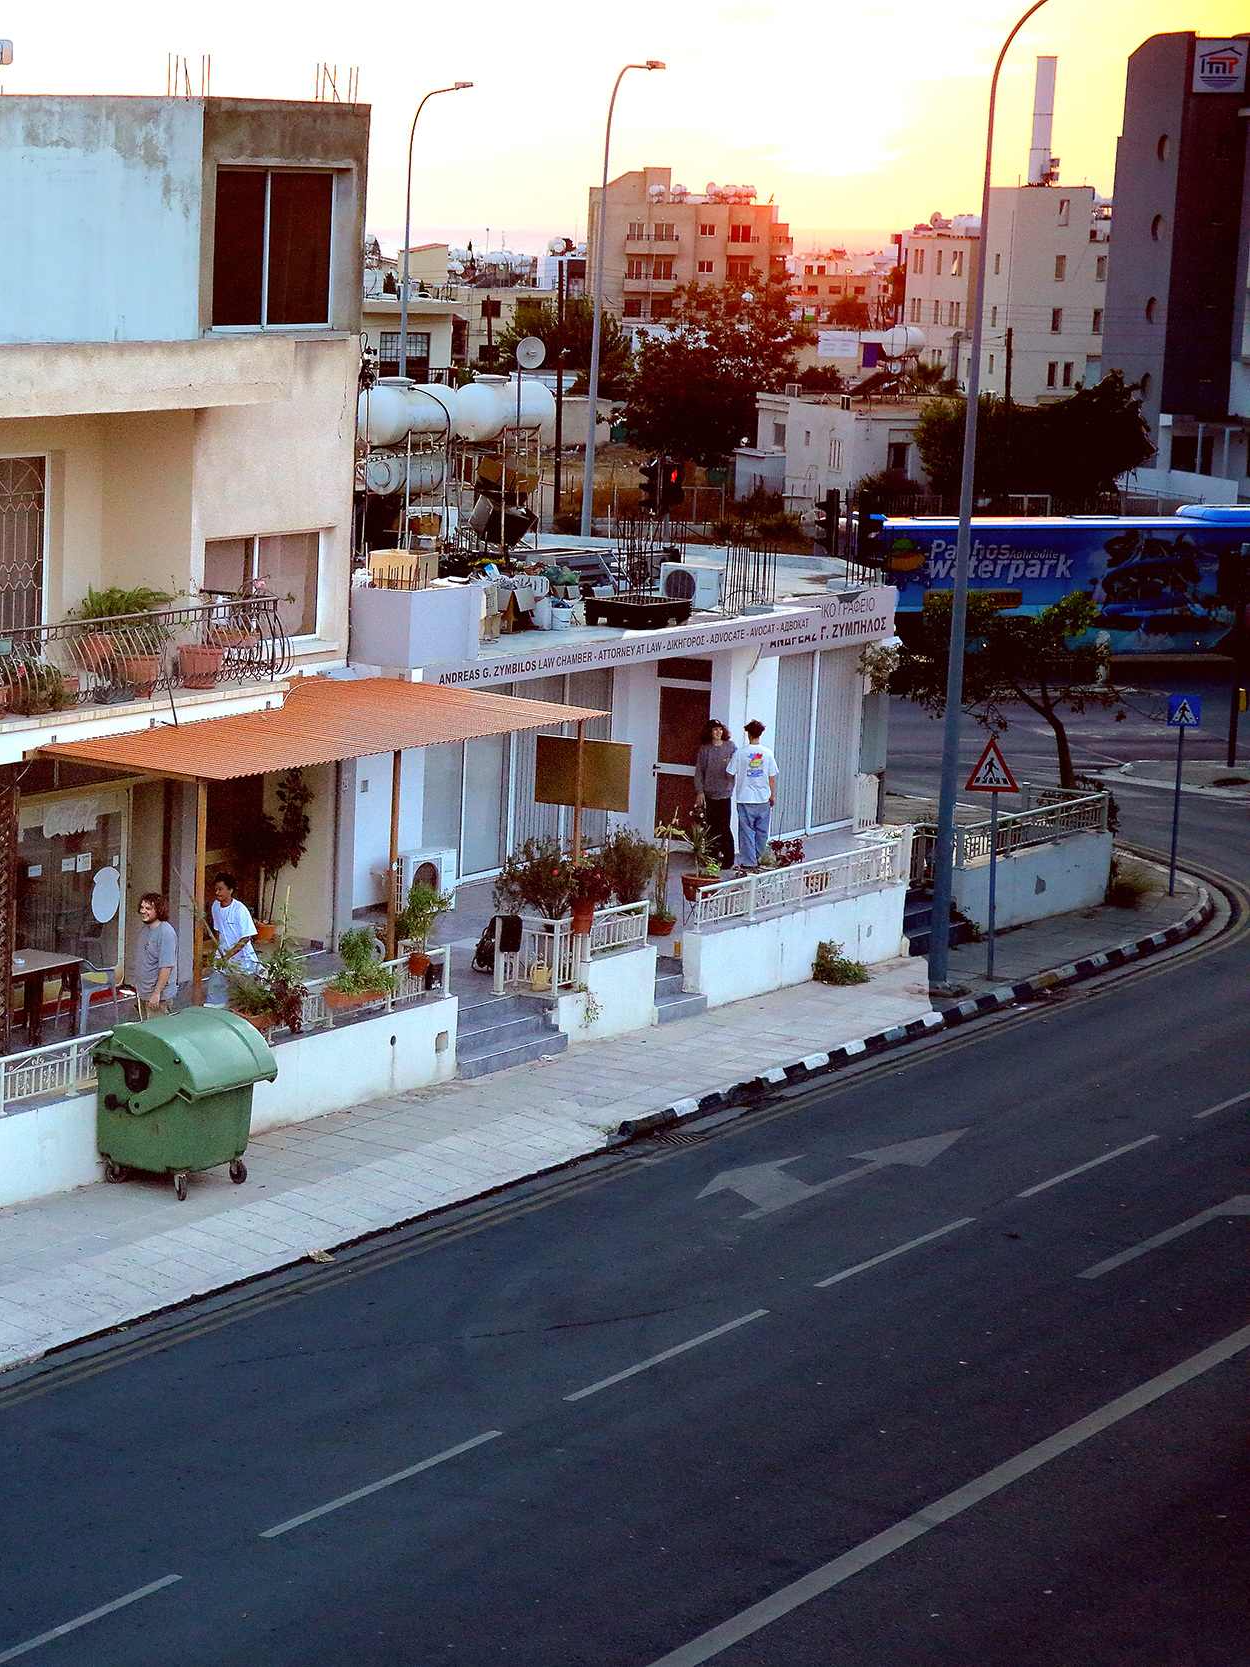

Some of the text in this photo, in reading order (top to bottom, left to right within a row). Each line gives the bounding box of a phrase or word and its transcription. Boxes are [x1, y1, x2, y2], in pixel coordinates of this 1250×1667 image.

[931, 539, 1011, 560] Pahos
[439, 669, 480, 685] ANDREAS
[482, 667, 492, 678] G.
[494, 661, 536, 677] ZYMBILOS
[538, 657, 556, 670] LAW
[556, 651, 593, 667] CHAMBER
[598, 646, 636, 661] ATTORNEY
[635, 644, 645, 655] AT
[646, 641, 662, 654] LAW
[710, 628, 745, 644] ADVOCATE
[750, 624, 776, 637] AVOCAT
